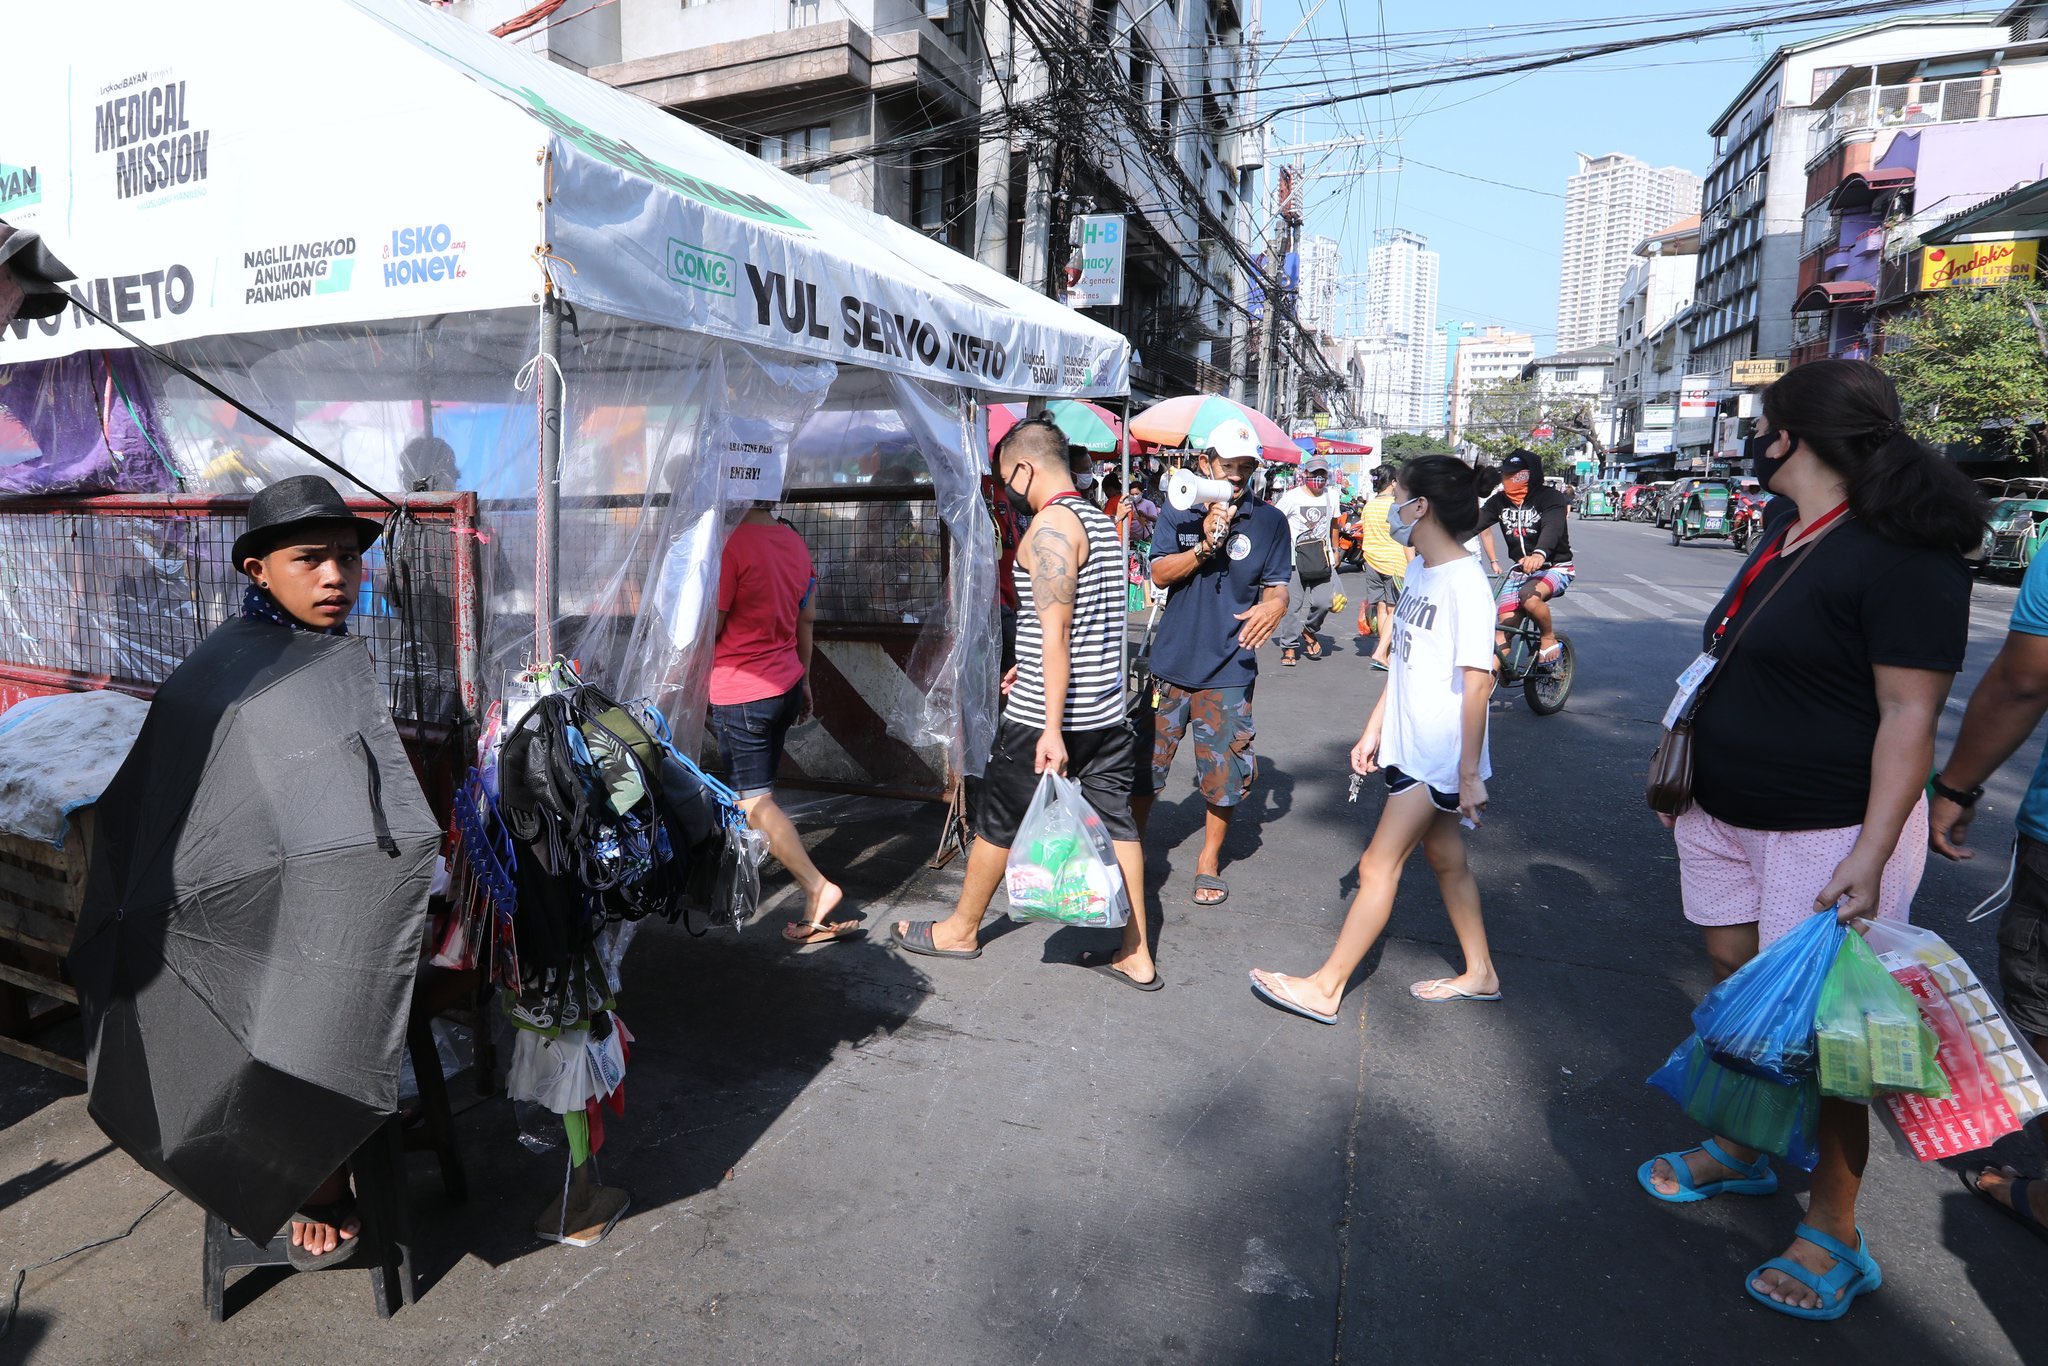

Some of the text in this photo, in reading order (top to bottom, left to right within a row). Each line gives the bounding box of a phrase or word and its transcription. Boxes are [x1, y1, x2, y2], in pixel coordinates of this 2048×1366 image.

[95, 80, 189, 153] MEDICAL
[116, 129, 209, 199] MISSION
[244, 237, 356, 268] NAGLILINGKOD
[392, 224, 450, 257] ISKO
[450, 240, 466, 251] ang
[254, 260, 328, 286] ANUMANG
[455, 268, 466, 278] ko
[674, 250, 730, 288] CONG.
[1089, 277, 1115, 286] generic
[1930, 245, 2016, 287] Andok's
[70, 264, 194, 330] NIETO
[245, 280, 311, 304] PANAHON
[745, 262, 1006, 381] YUL SERVO NIETO
[758, 444, 773, 454] PASS
[730, 467, 760, 480] ENTRY!
